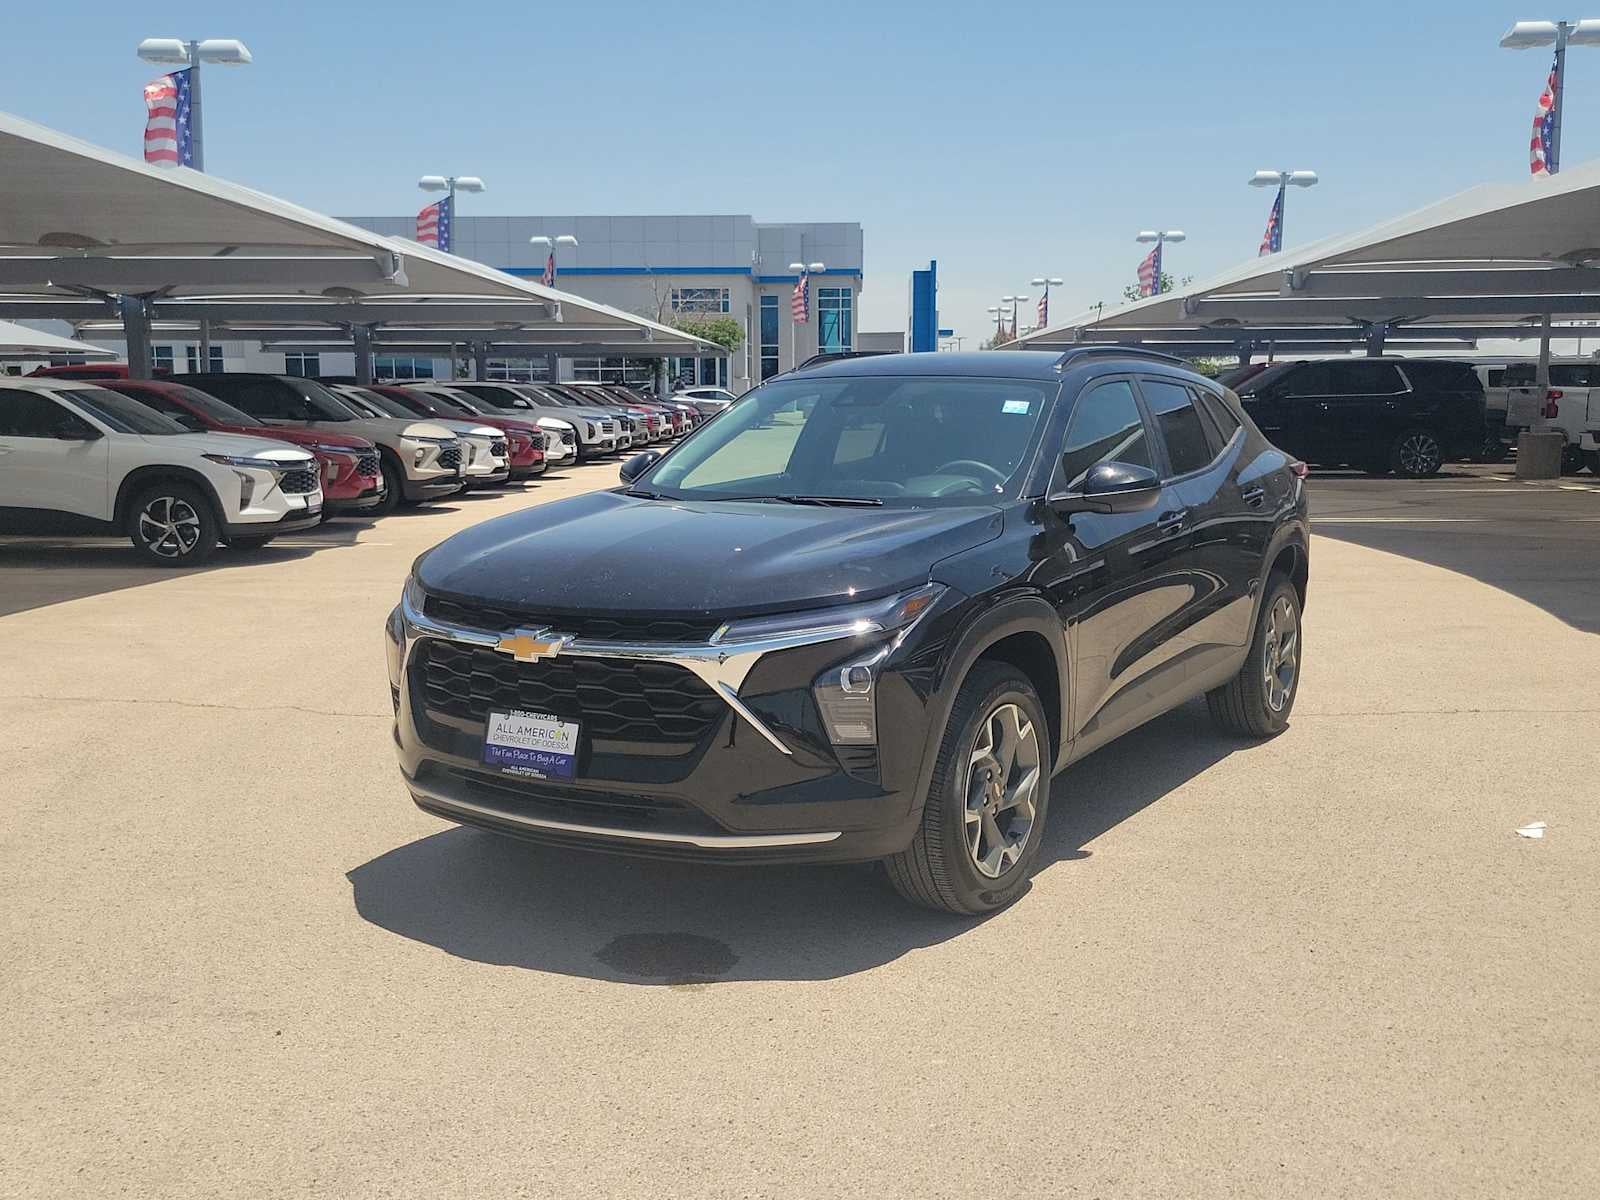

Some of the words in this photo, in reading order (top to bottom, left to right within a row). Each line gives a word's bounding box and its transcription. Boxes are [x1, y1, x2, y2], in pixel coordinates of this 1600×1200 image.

[496, 723, 513, 733] ALL
[517, 726, 569, 742] AMERICAN
[493, 734, 530, 745] CHEVROLET
[543, 740, 569, 750] ODESSA
